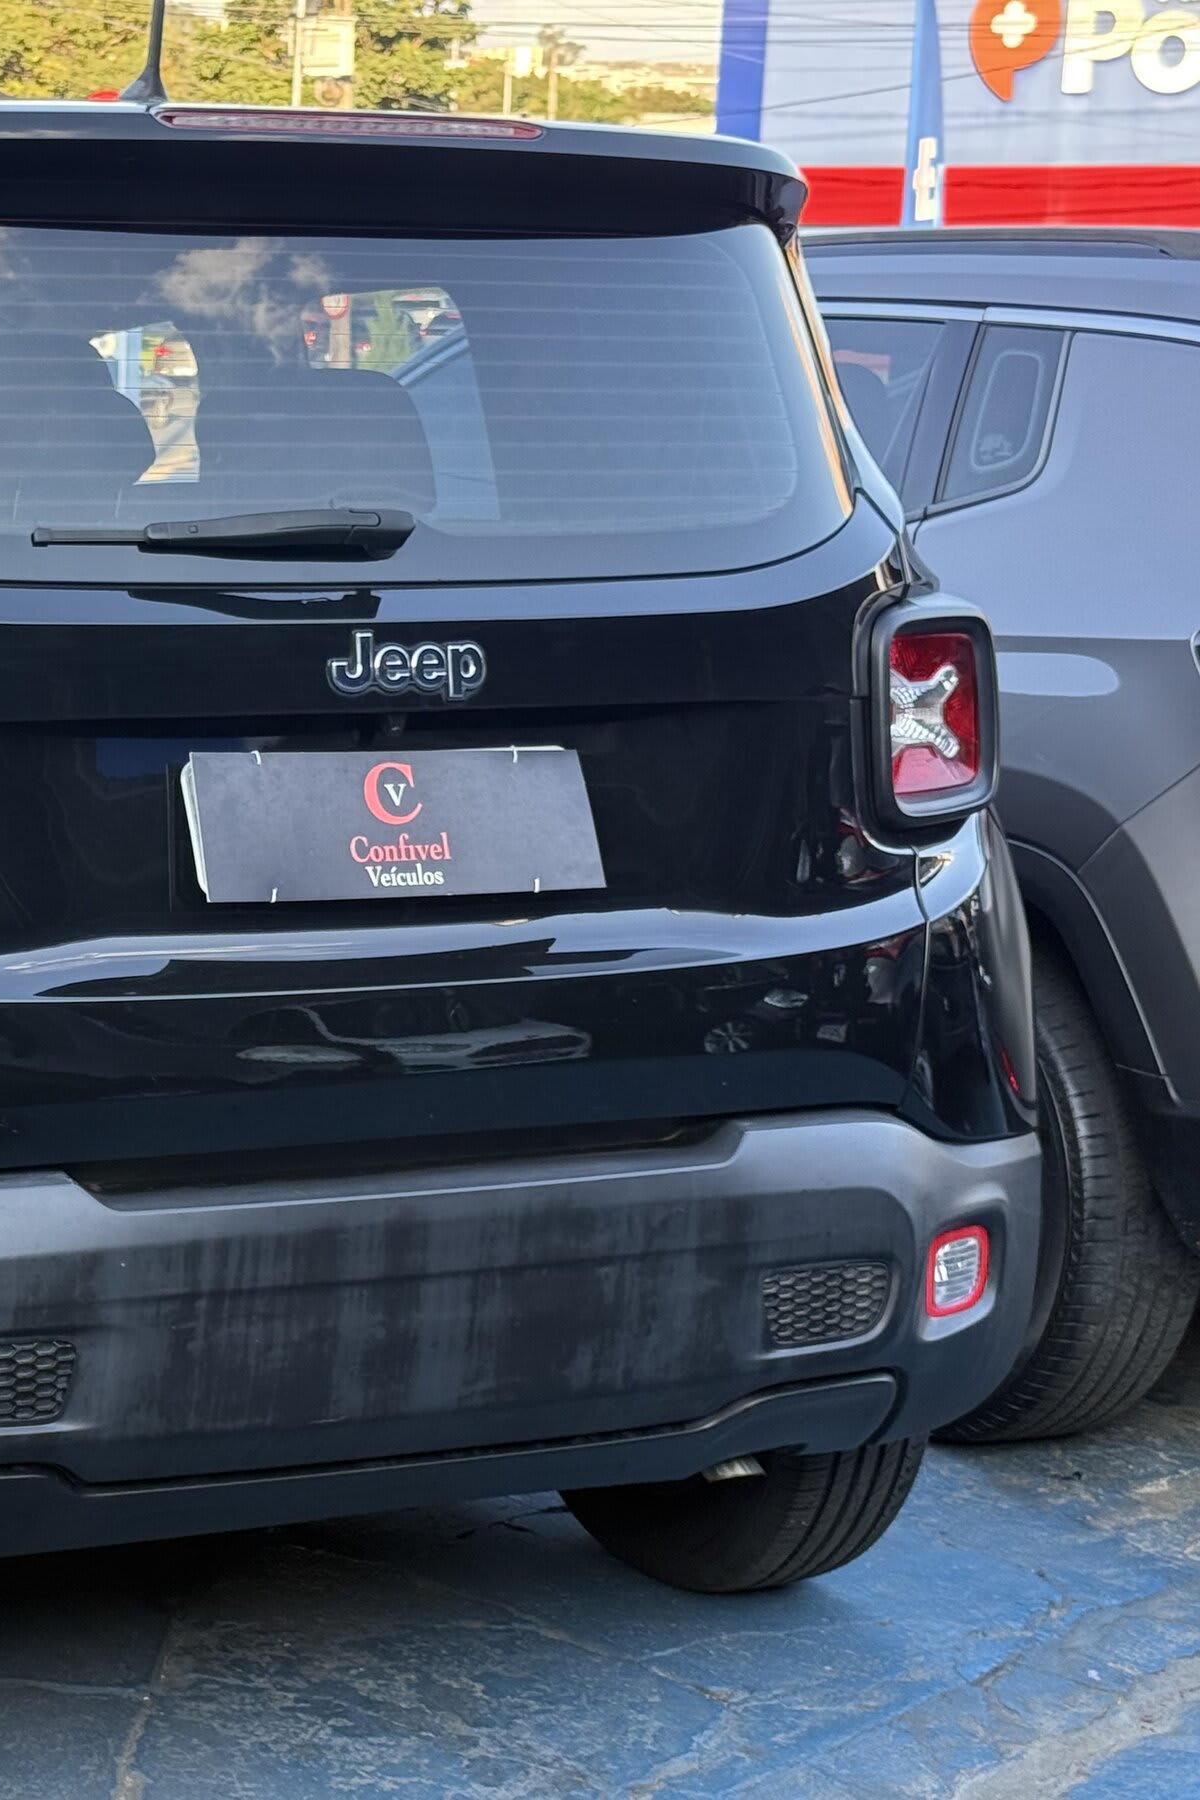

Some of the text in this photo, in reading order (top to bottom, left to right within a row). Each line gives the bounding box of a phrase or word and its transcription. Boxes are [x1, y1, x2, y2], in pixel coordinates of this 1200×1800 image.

[326, 630, 486, 700] Jeep
[349, 831, 453, 864] Confivel
[364, 862, 445, 887] Veículos
